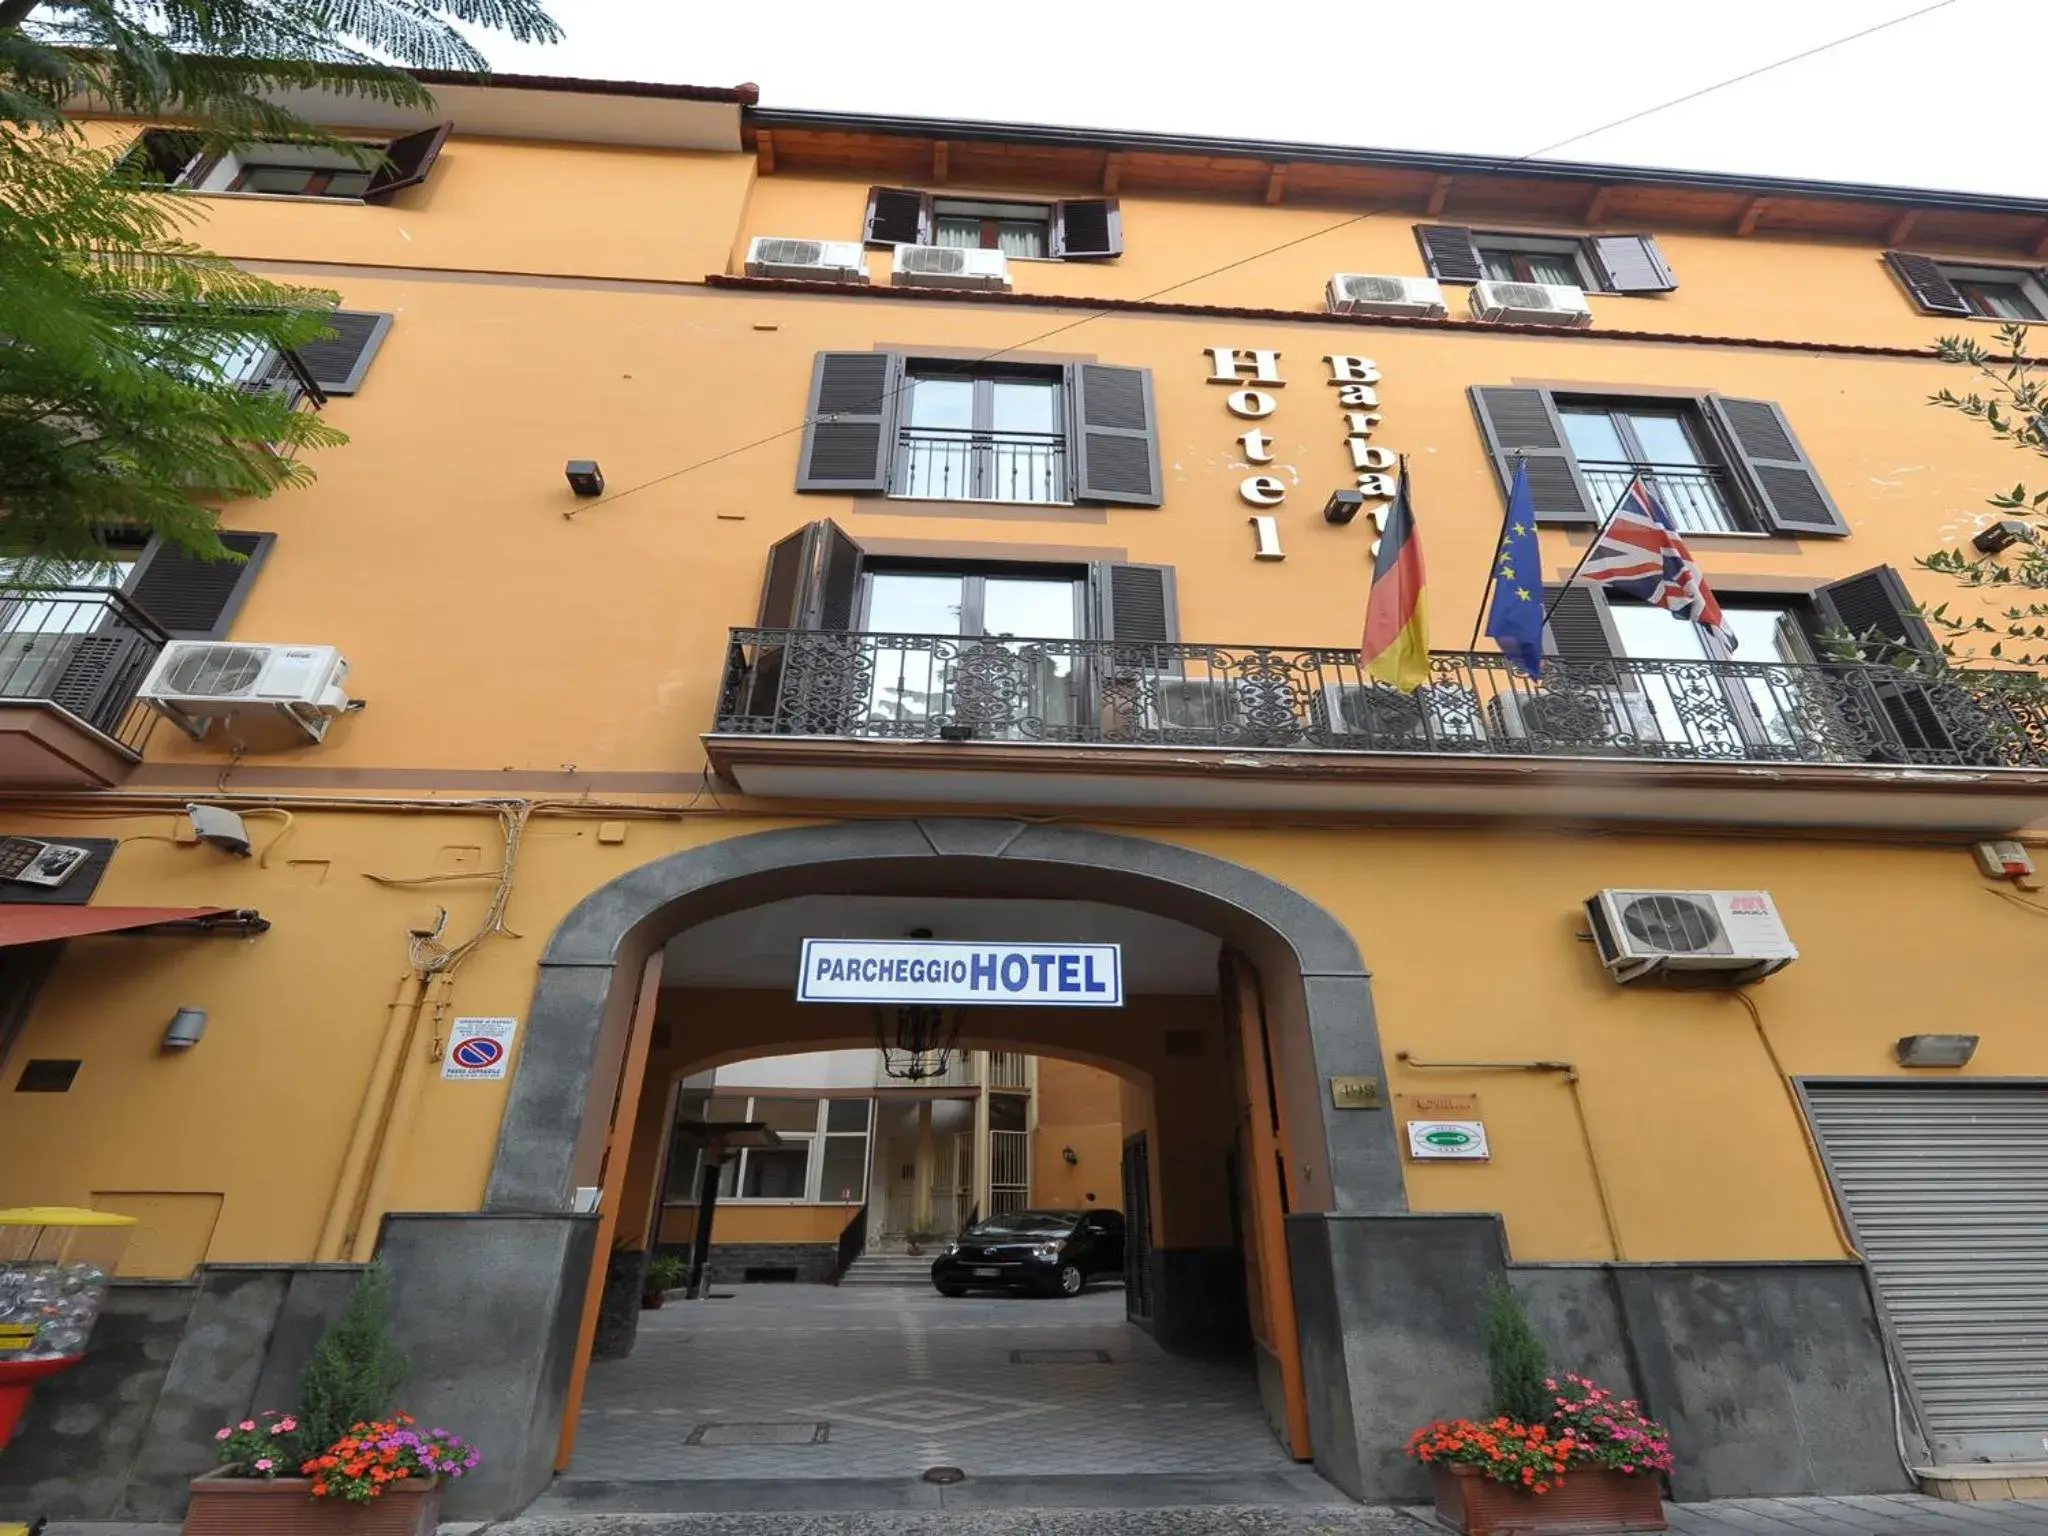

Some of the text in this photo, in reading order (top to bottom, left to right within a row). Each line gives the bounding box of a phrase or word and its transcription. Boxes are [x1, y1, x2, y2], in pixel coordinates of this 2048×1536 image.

[1202, 347, 1286, 561] Hotel
[816, 952, 1107, 993] PARCHEGGIO HOTEL
